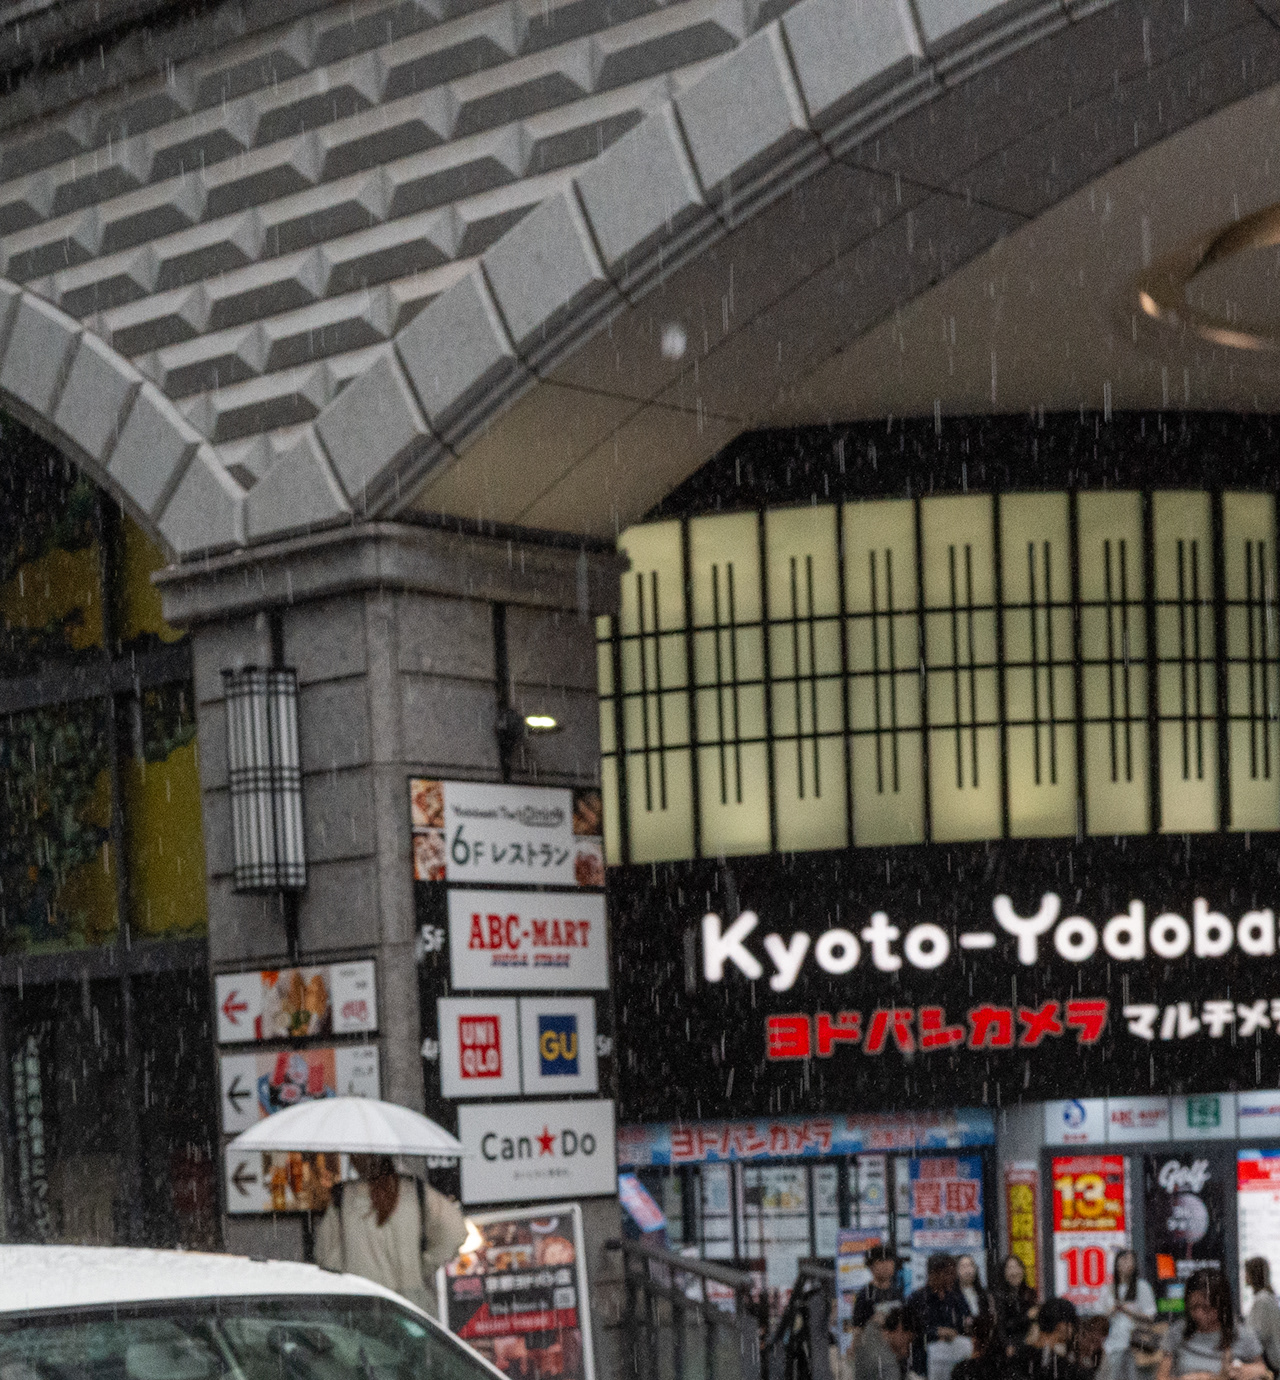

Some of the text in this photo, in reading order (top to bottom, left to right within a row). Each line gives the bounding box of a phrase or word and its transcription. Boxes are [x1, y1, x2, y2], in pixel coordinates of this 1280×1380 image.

[451, 824, 570, 867] 6F レストラン
[468, 912, 591, 951] ABC-MART
[462, 1021, 497, 1047] UNI
[539, 1030, 579, 1061] GU
[766, 999, 1109, 1061] ヨドバシカメラ
[463, 1048, 500, 1075] QLO
[1158, 1159, 1212, 1194] Golf
